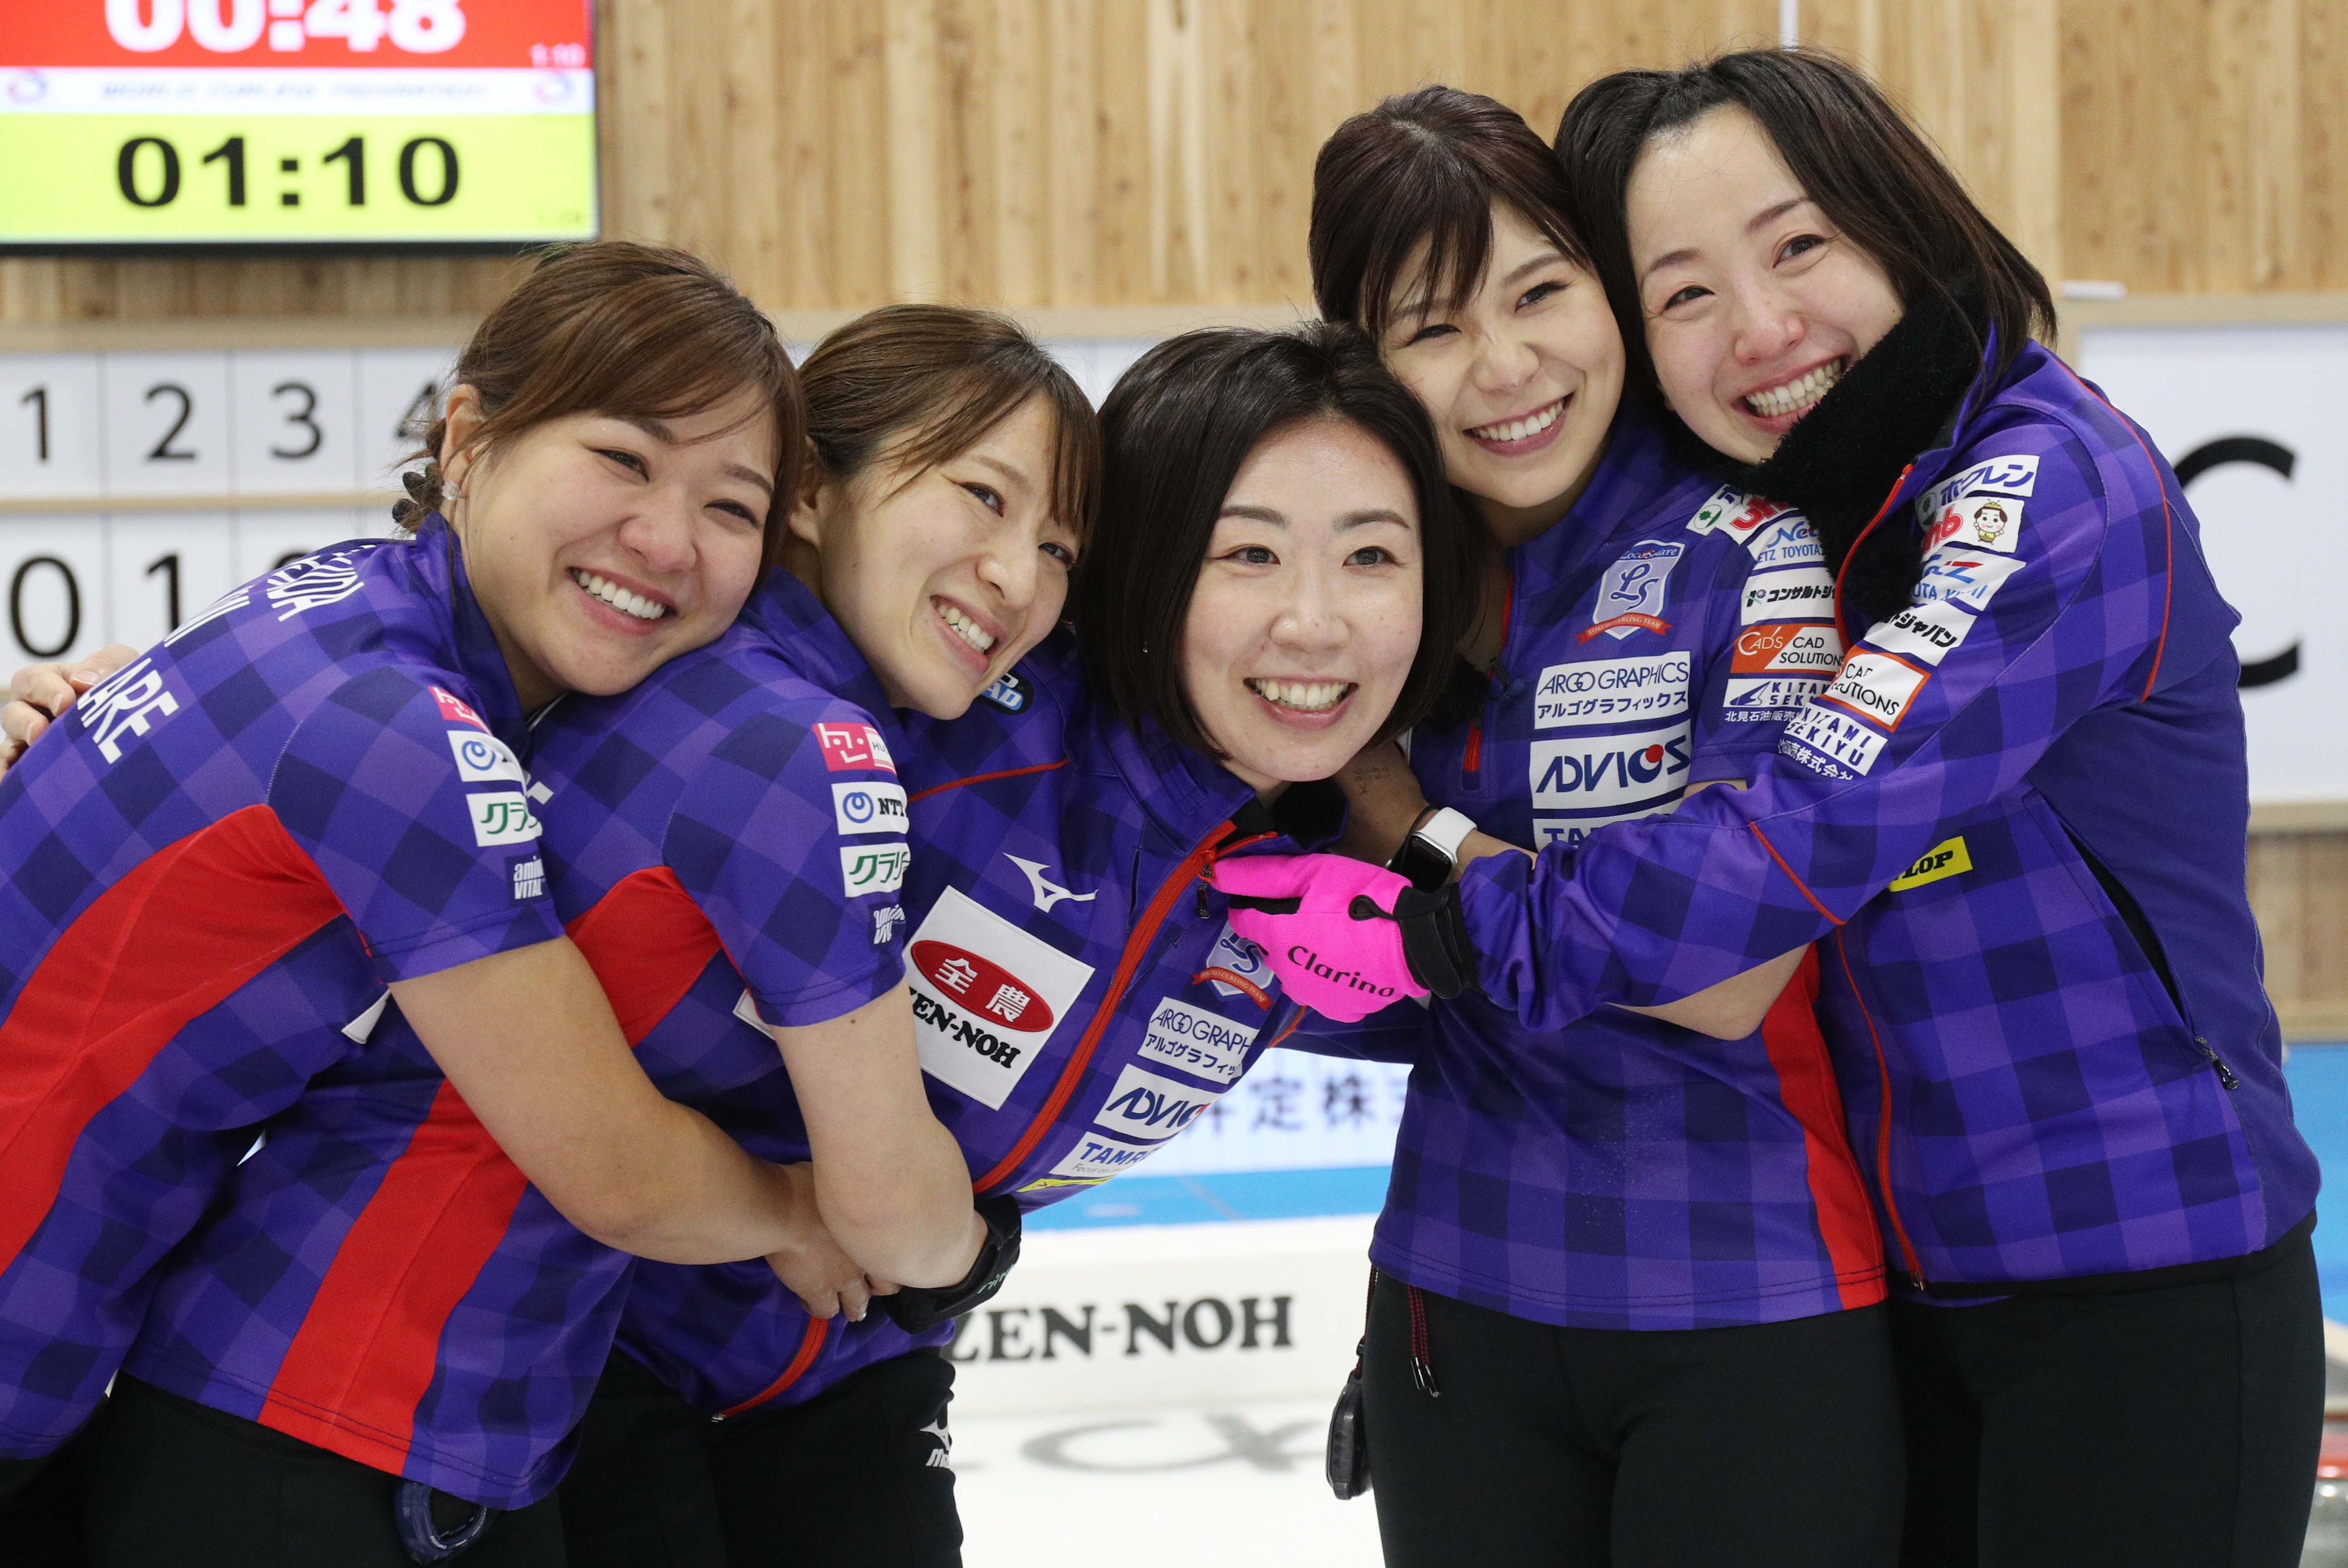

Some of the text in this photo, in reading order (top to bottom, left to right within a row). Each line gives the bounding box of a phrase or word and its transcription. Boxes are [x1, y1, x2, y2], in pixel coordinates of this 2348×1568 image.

[116, 136, 461, 207] 01:10
[20, 386, 50, 463] 1
[143, 381, 196, 461] 2
[270, 381, 323, 460] 3
[1941, 464, 2035, 506] ホクレン
[1756, 549, 1776, 563] ETZ
[8, 554, 81, 659] 0
[1767, 586, 1836, 602] コンサルトジ
[1793, 637, 1824, 648] CAD
[1598, 662, 1689, 688] GRAPHICS
[1537, 690, 1687, 719] アルゴグラフィックス
[1725, 710, 1799, 722] 北見石油販売
[934, 958, 1032, 1023] 全農
[1287, 945, 1395, 998] Clarino
[910, 986, 1021, 1069] EN-NOH
[1192, 1020, 1251, 1055] GRAPH
[1146, 1033, 1237, 1076] アルゴグラフィッ
